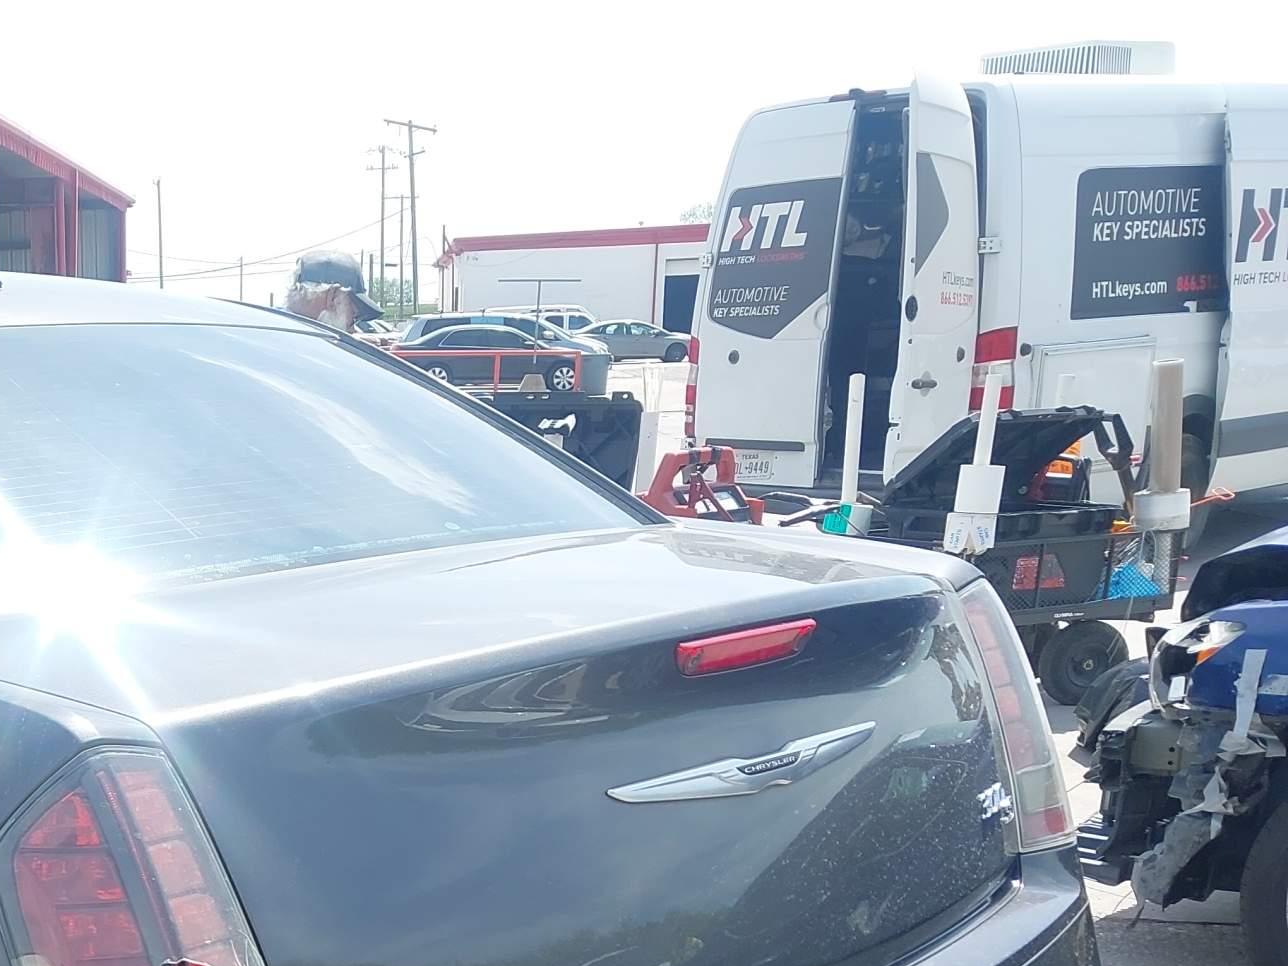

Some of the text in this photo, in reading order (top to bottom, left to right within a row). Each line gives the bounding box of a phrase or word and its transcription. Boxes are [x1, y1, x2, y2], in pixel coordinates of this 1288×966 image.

[1091, 187, 1201, 216] AUTOMOTIVE
[720, 200, 808, 253] HTL
[1092, 218, 1207, 242] KEY SPECIALISTS
[1234, 188, 1288, 262] H
[718, 257, 736, 266] HIGH
[737, 255, 756, 264] TECH
[1233, 273, 1256, 285] HIGH
[1259, 271, 1280, 283] TECH
[714, 286, 790, 304] AUTOMOTIVE
[1092, 280, 1168, 300] HTLkeys.com
[713, 305, 781, 318] KEY SPECIALISTS
[744, 756, 796, 774] CHRYSLER
